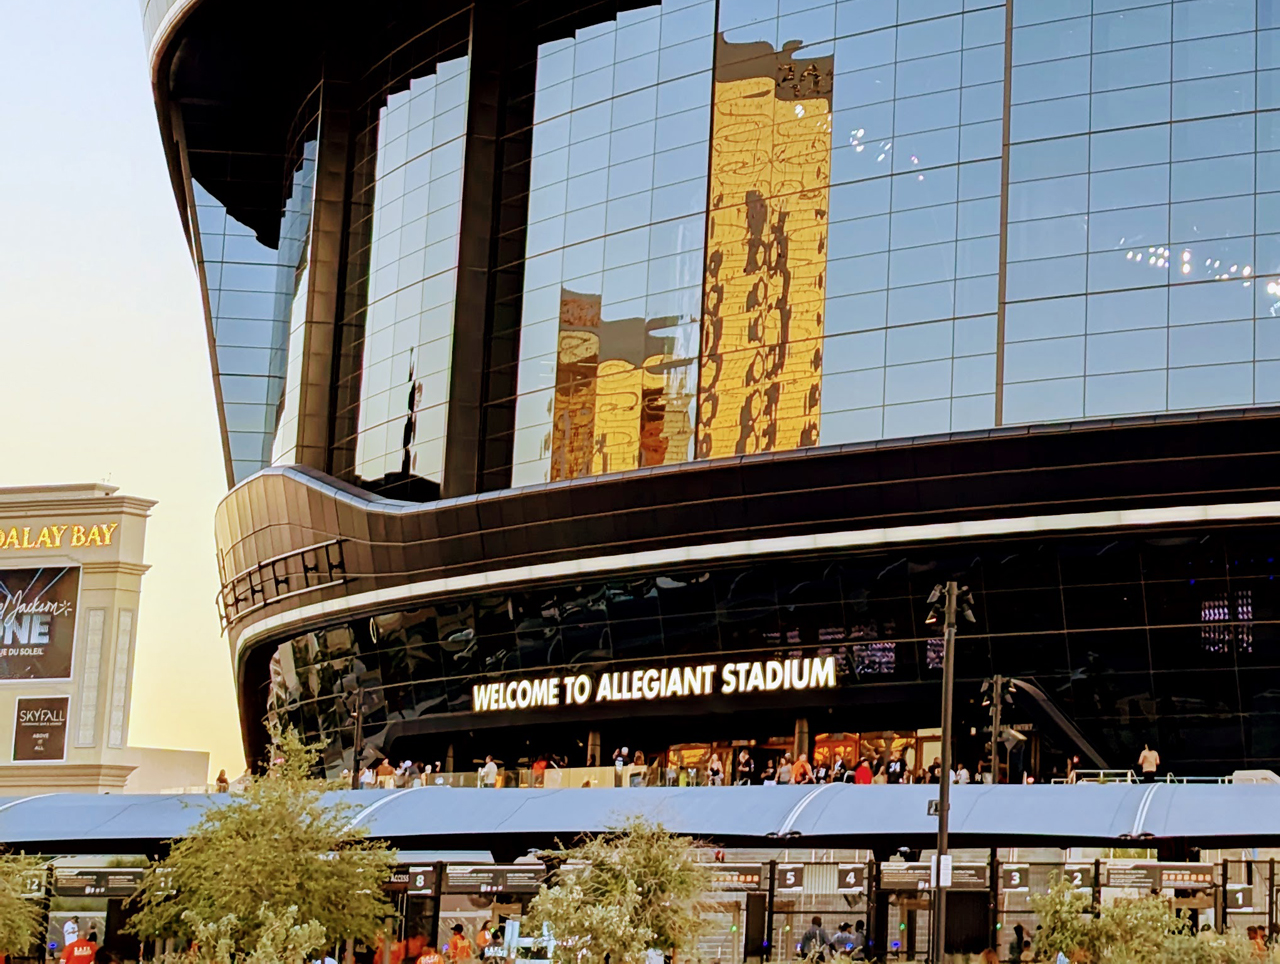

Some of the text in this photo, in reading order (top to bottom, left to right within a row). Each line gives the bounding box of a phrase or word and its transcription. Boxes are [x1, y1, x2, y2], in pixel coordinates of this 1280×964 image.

[70, 523, 118, 547] BAY
[0, 615, 51, 645] NE
[472, 656, 838, 712] WELCOME TO ALLEGIANT STADIUM
[20, 708, 65, 722] SKYFALL
[416, 875, 424, 887] 8
[786, 872, 795, 884] 5
[846, 872, 855, 884] 4
[1011, 872, 1020, 884] 3
[1073, 872, 1082, 885] 2
[1235, 892, 1243, 905] 1
